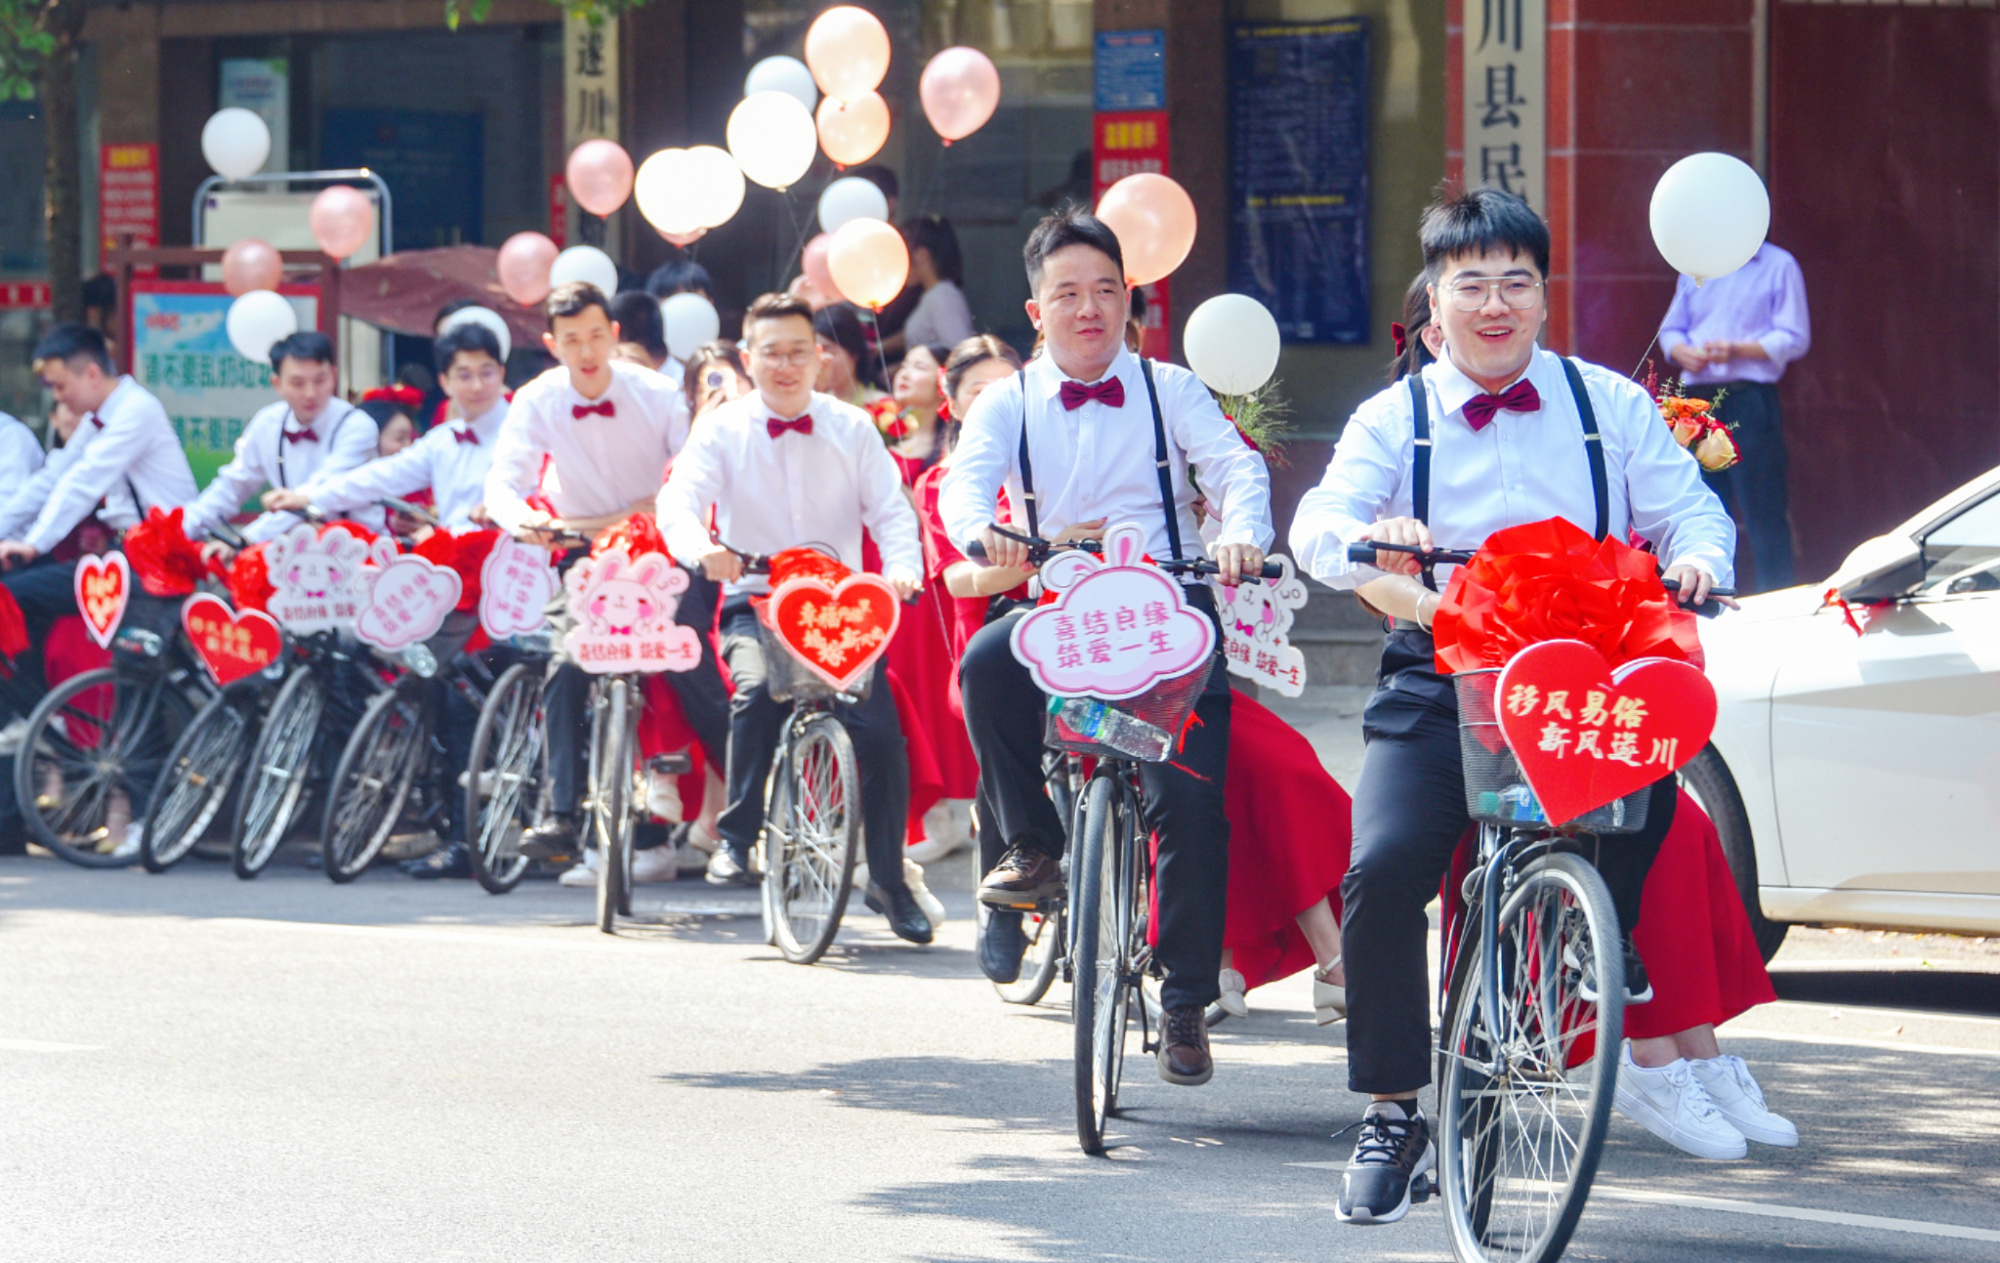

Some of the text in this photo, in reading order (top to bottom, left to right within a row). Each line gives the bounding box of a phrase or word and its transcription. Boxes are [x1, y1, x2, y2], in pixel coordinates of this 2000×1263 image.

[1053, 600, 1171, 642] 喜结良缘
[1057, 631, 1175, 669] 筑爱一生
[1256, 649, 1299, 686] 筑爱一生
[1506, 683, 1649, 729] 移风易俗
[1537, 722, 1679, 771] 新风遂川
